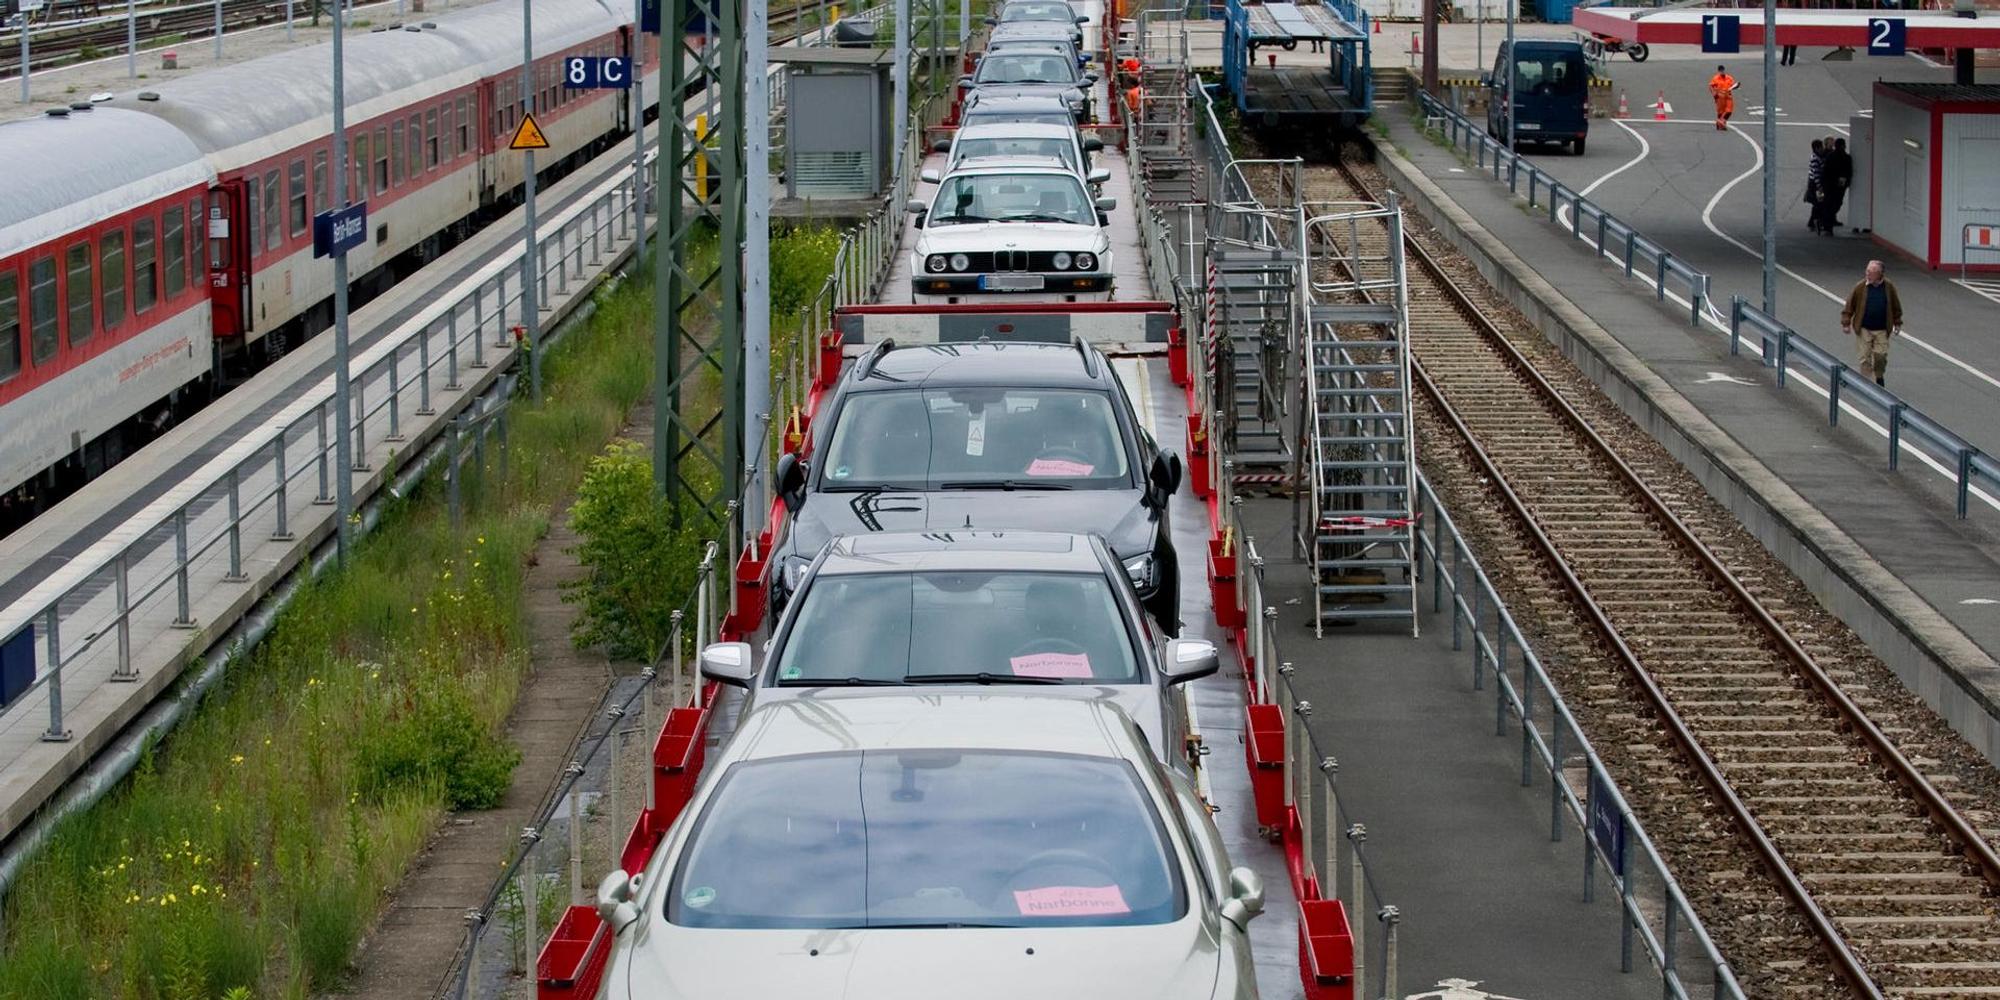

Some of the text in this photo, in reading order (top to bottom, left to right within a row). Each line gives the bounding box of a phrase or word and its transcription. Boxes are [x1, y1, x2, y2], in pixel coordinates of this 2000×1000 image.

[1706, 16, 1719, 45] 1
[1871, 19, 1891, 48] 2
[569, 57, 622, 84] 8 C
[1027, 898, 1115, 911] Narbonne
